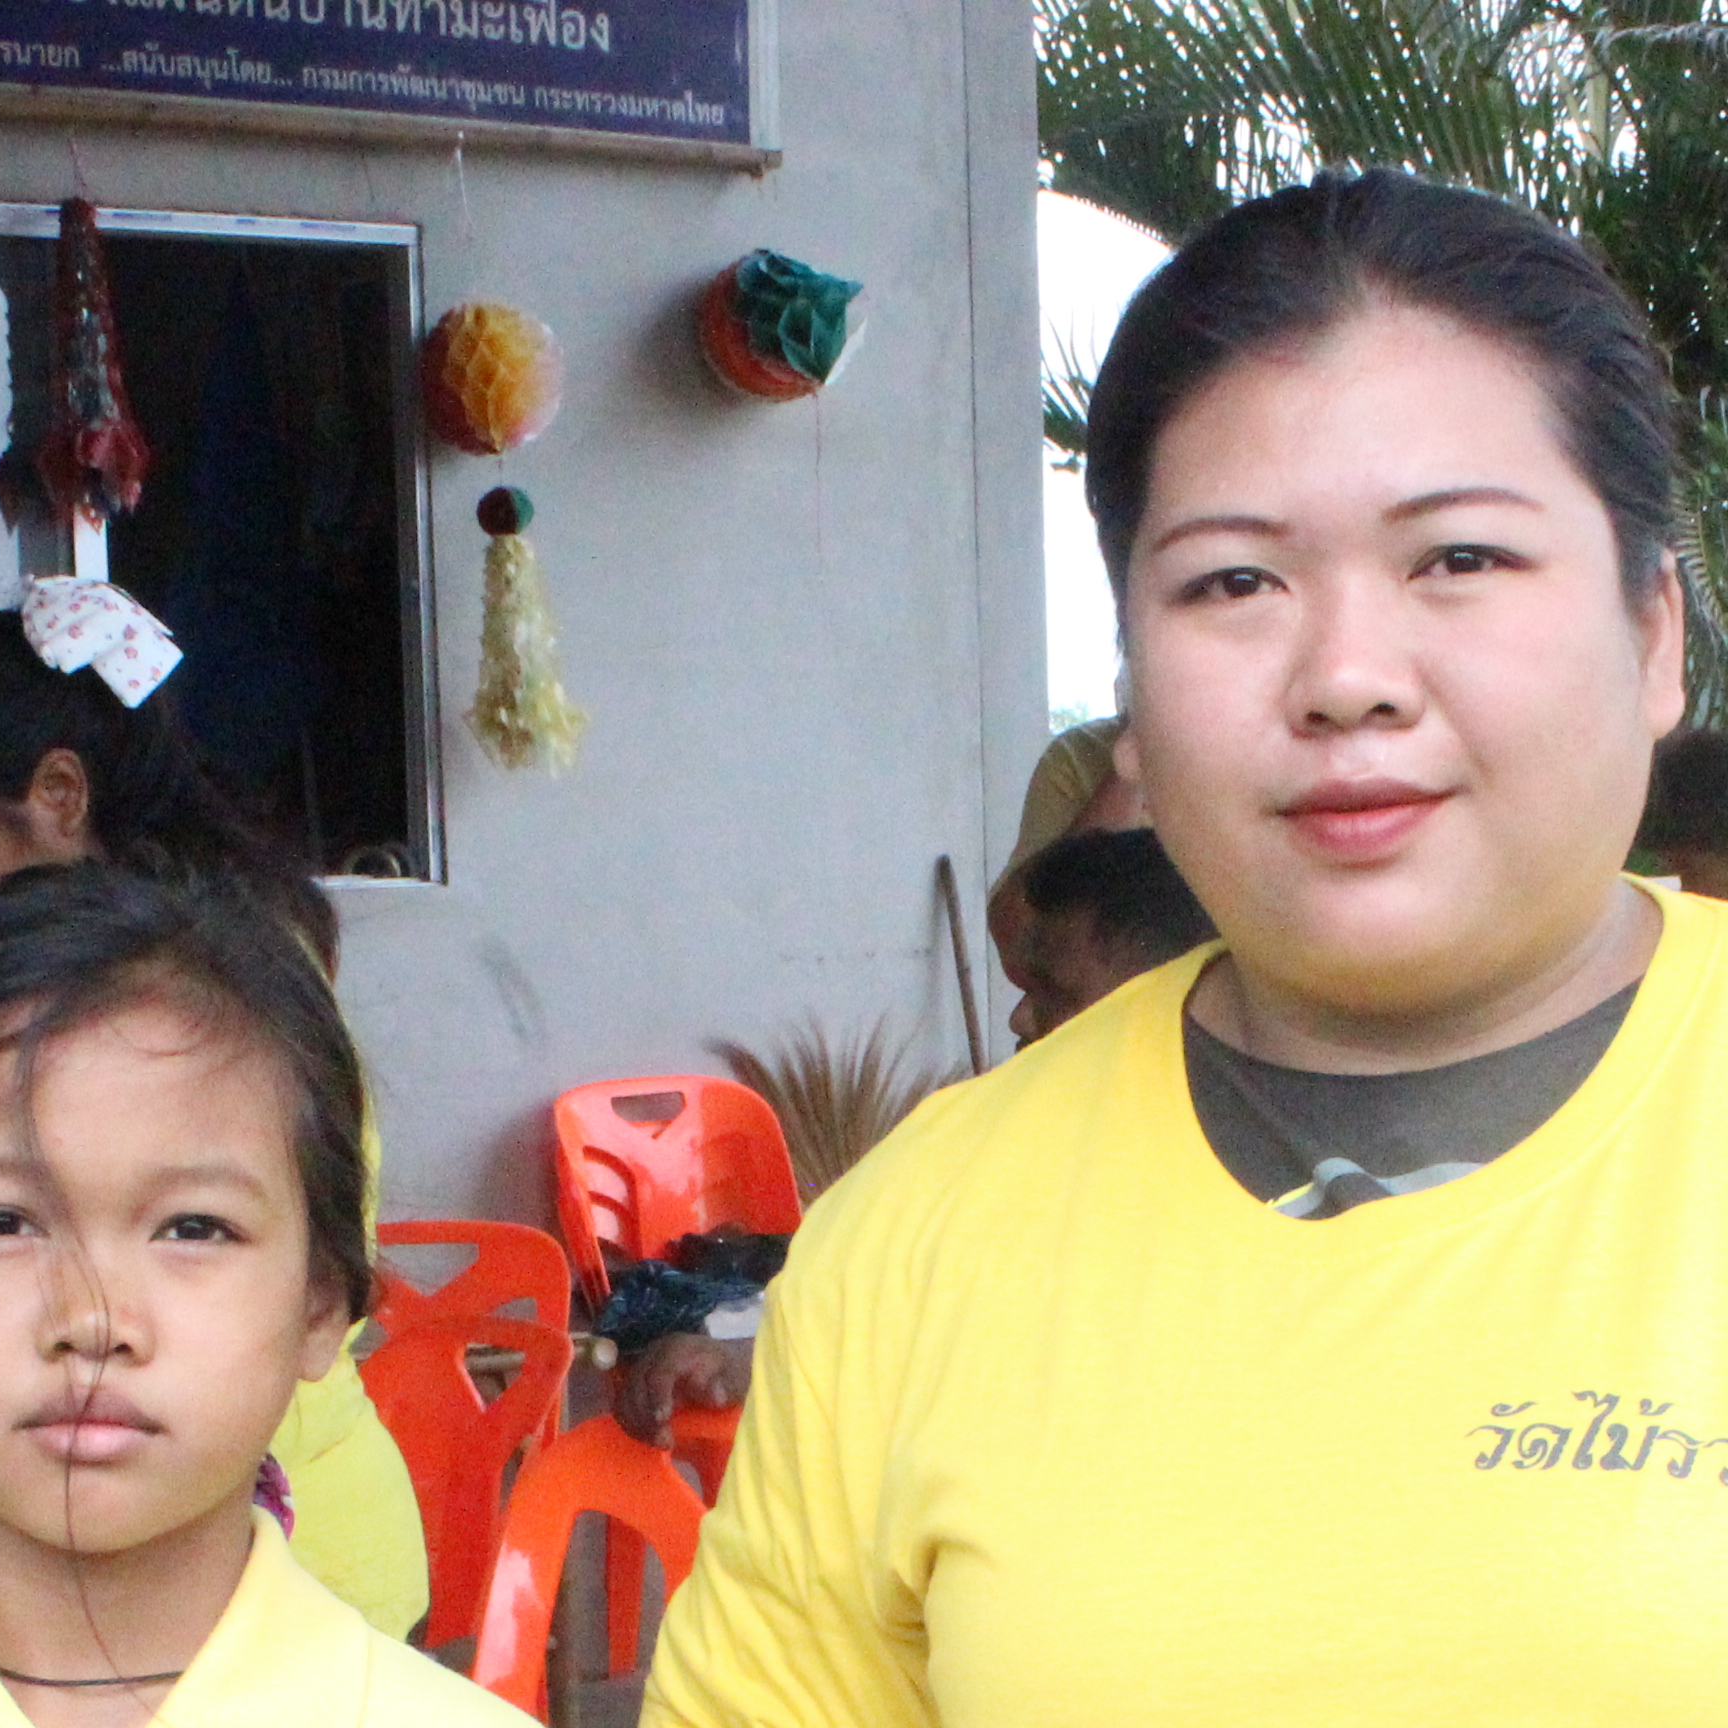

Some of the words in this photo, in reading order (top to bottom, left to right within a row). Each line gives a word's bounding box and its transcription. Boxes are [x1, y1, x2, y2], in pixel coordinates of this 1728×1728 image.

[534, 89, 724, 126] กระทรวงมหาดไทย
